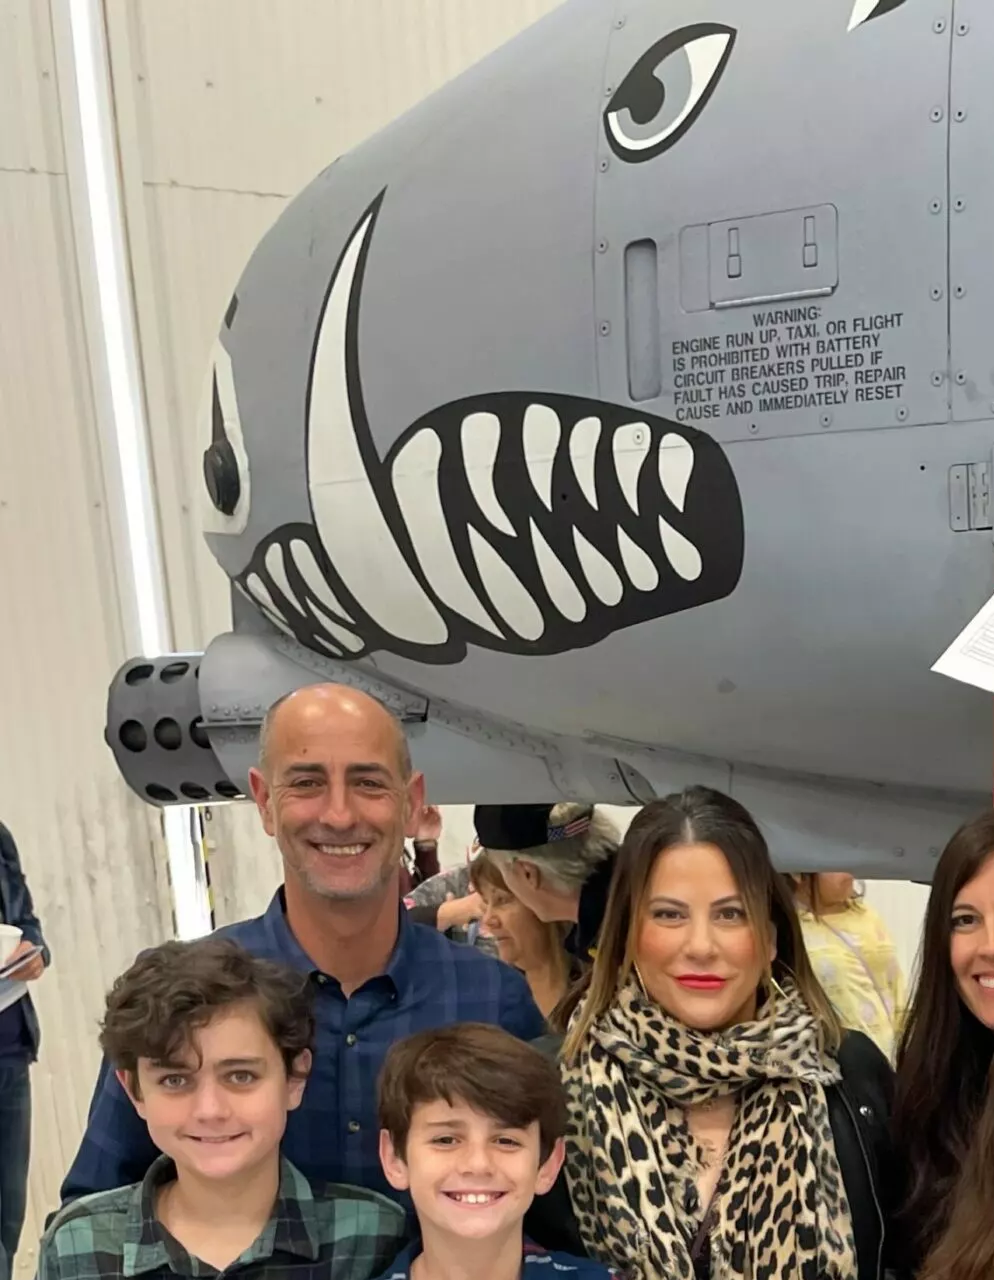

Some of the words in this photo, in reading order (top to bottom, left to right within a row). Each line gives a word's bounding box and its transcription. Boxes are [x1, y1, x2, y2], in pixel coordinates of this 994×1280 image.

[672, 335, 720, 355] ENGINE
[726, 331, 754, 348] RUN
[826, 320, 846, 335] OR
[853, 312, 904, 332] FLIGHT
[752, 306, 822, 327] WARNING:
[672, 357, 686, 372] IS
[690, 347, 769, 369] PROHIBITED
[775, 341, 811, 359] WITH
[816, 332, 880, 354] BATTERY
[673, 369, 726, 388] CIRCUIT
[731, 359, 805, 382] BREAKERS
[810, 352, 865, 373] PULLED
[870, 350, 883, 366] IF
[673, 387, 714, 405] FAULT
[718, 383, 746, 400] HAS
[751, 376, 809, 396] CAUSED
[855, 365, 906, 385] REPAIR
[675, 403, 720, 421] CAUSE
[726, 400, 753, 416] AND
[759, 389, 849, 412] IMMEDIATELY
[855, 383, 904, 402] RESET
